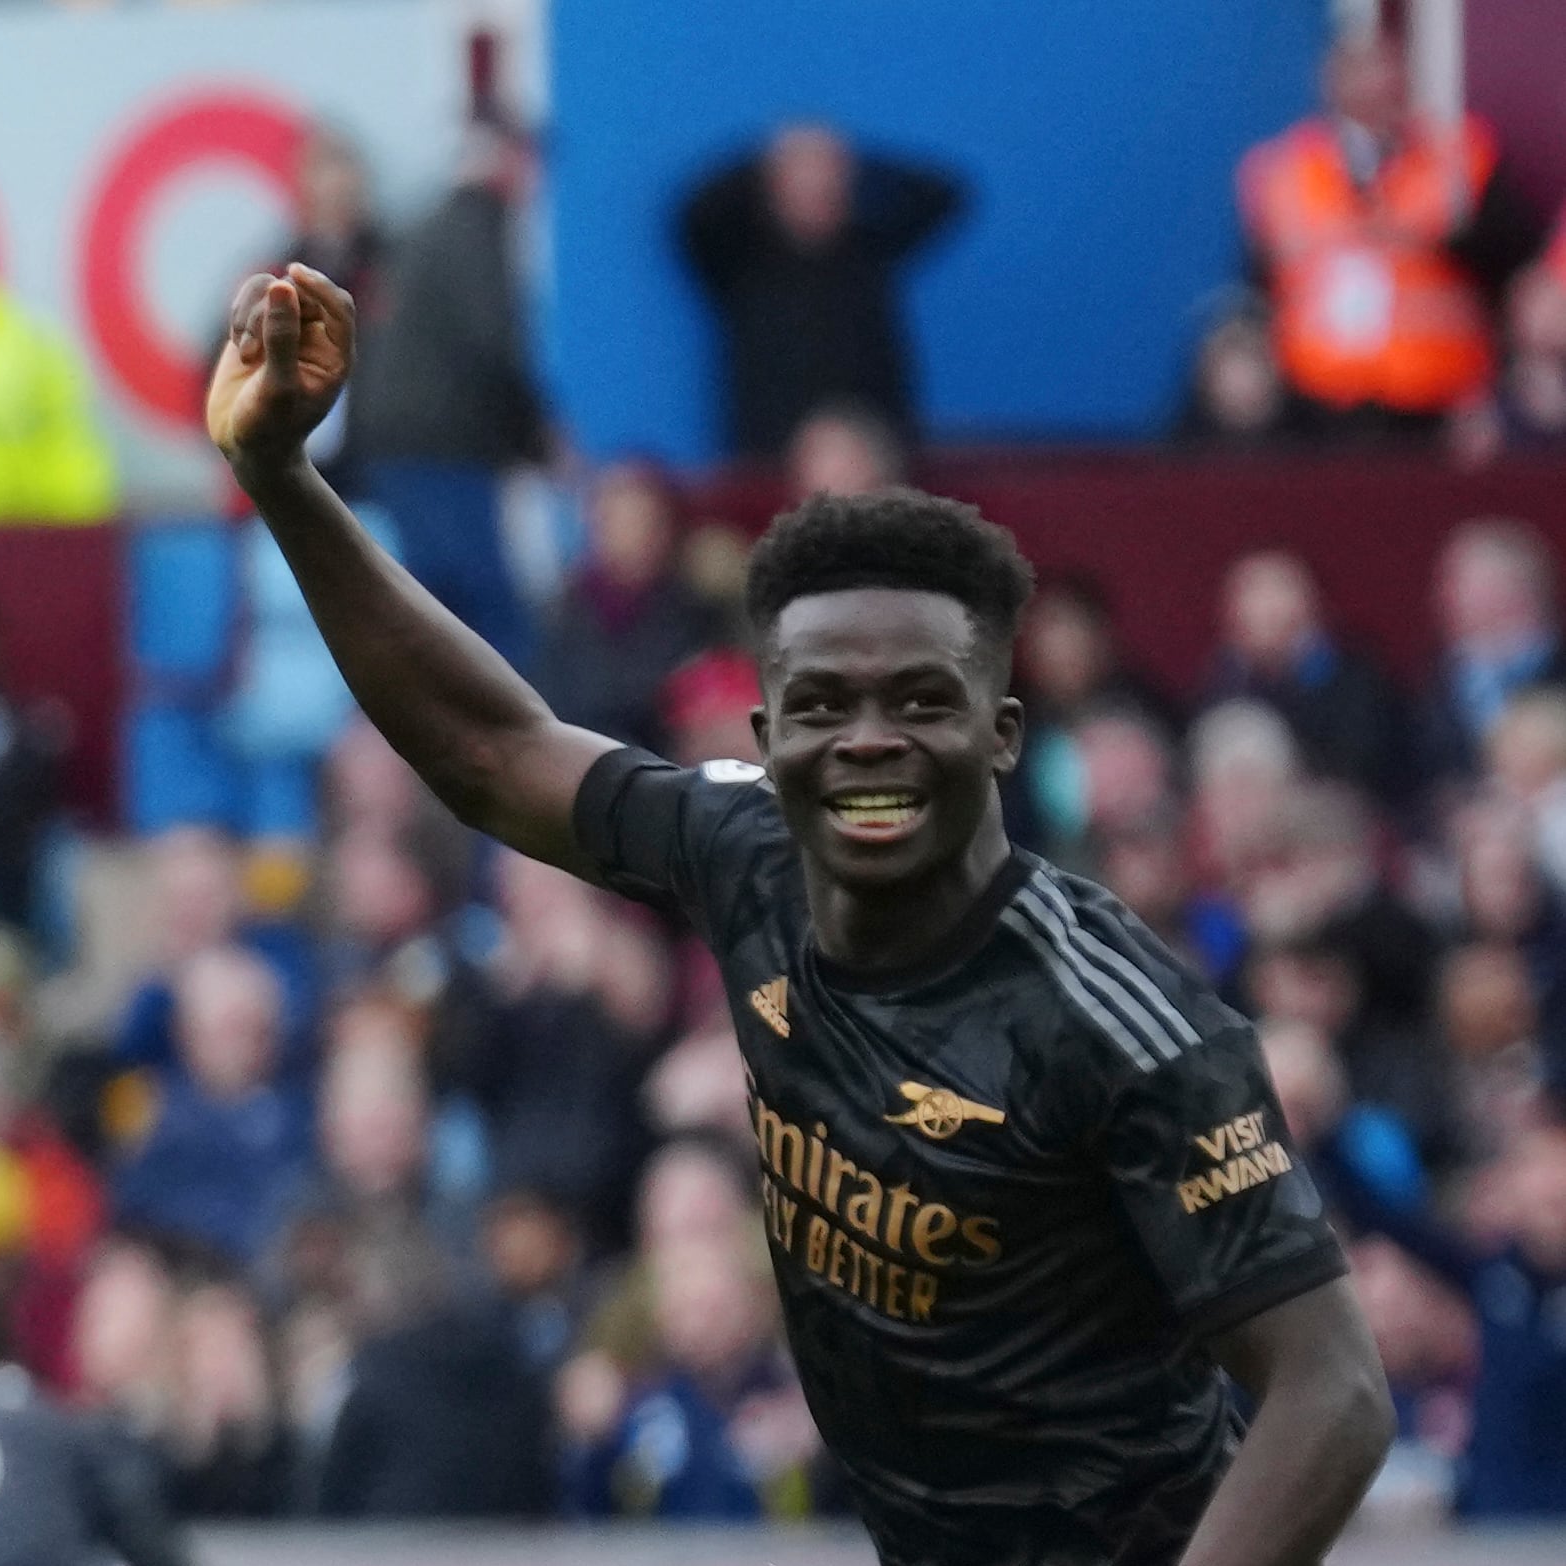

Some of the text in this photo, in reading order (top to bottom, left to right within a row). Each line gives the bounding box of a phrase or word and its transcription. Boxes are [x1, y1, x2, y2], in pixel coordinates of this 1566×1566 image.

[756, 1094, 1002, 1268] mirates
[1176, 1141, 1293, 1214] RWAN
[1194, 1110, 1267, 1162] VISIT
[806, 1214, 939, 1321] BETTER
